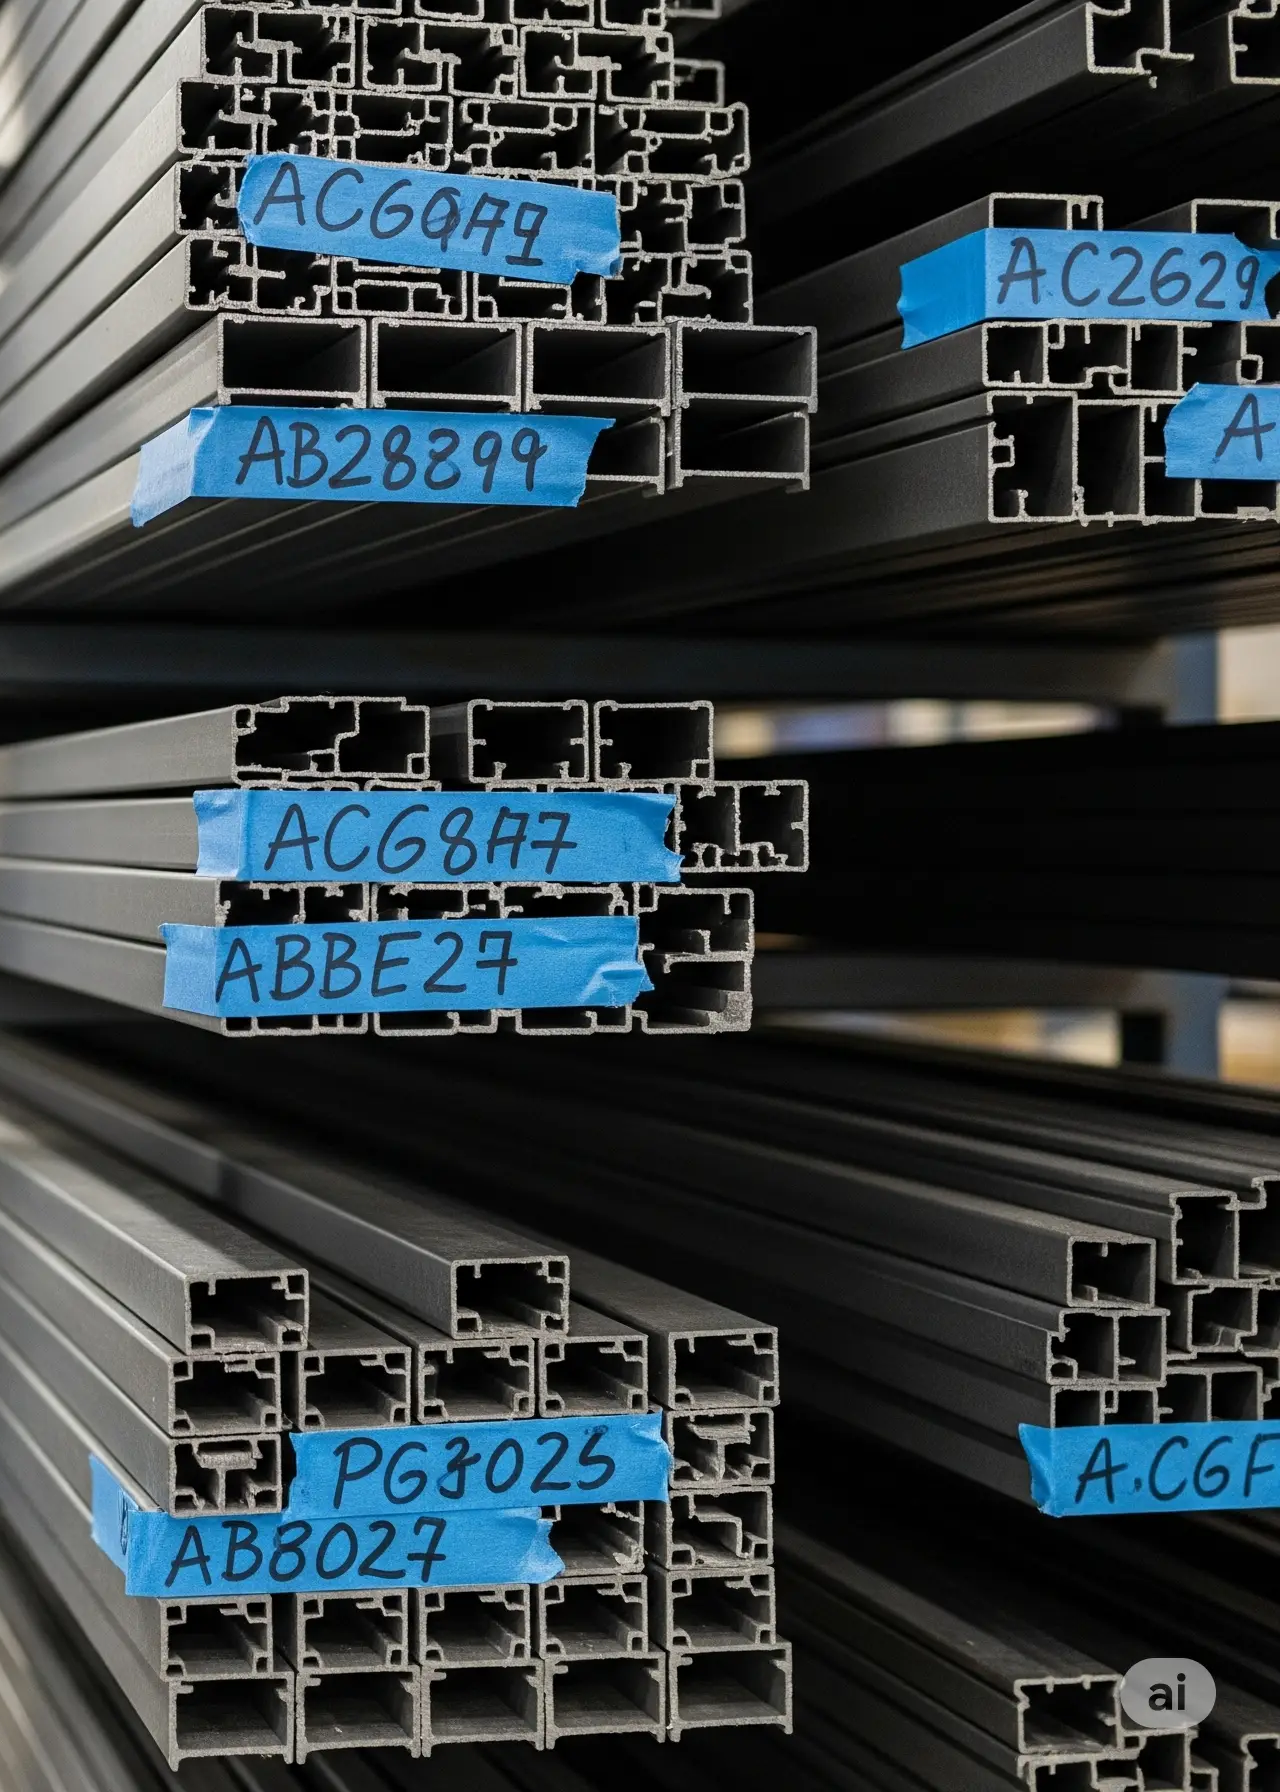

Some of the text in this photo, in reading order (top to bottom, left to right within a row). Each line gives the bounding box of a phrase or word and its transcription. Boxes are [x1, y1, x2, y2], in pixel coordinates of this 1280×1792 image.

[1215, 393, 1277, 462] A
[215, 930, 519, 1004] ABBE27
[164, 1516, 447, 1588] AB8027
